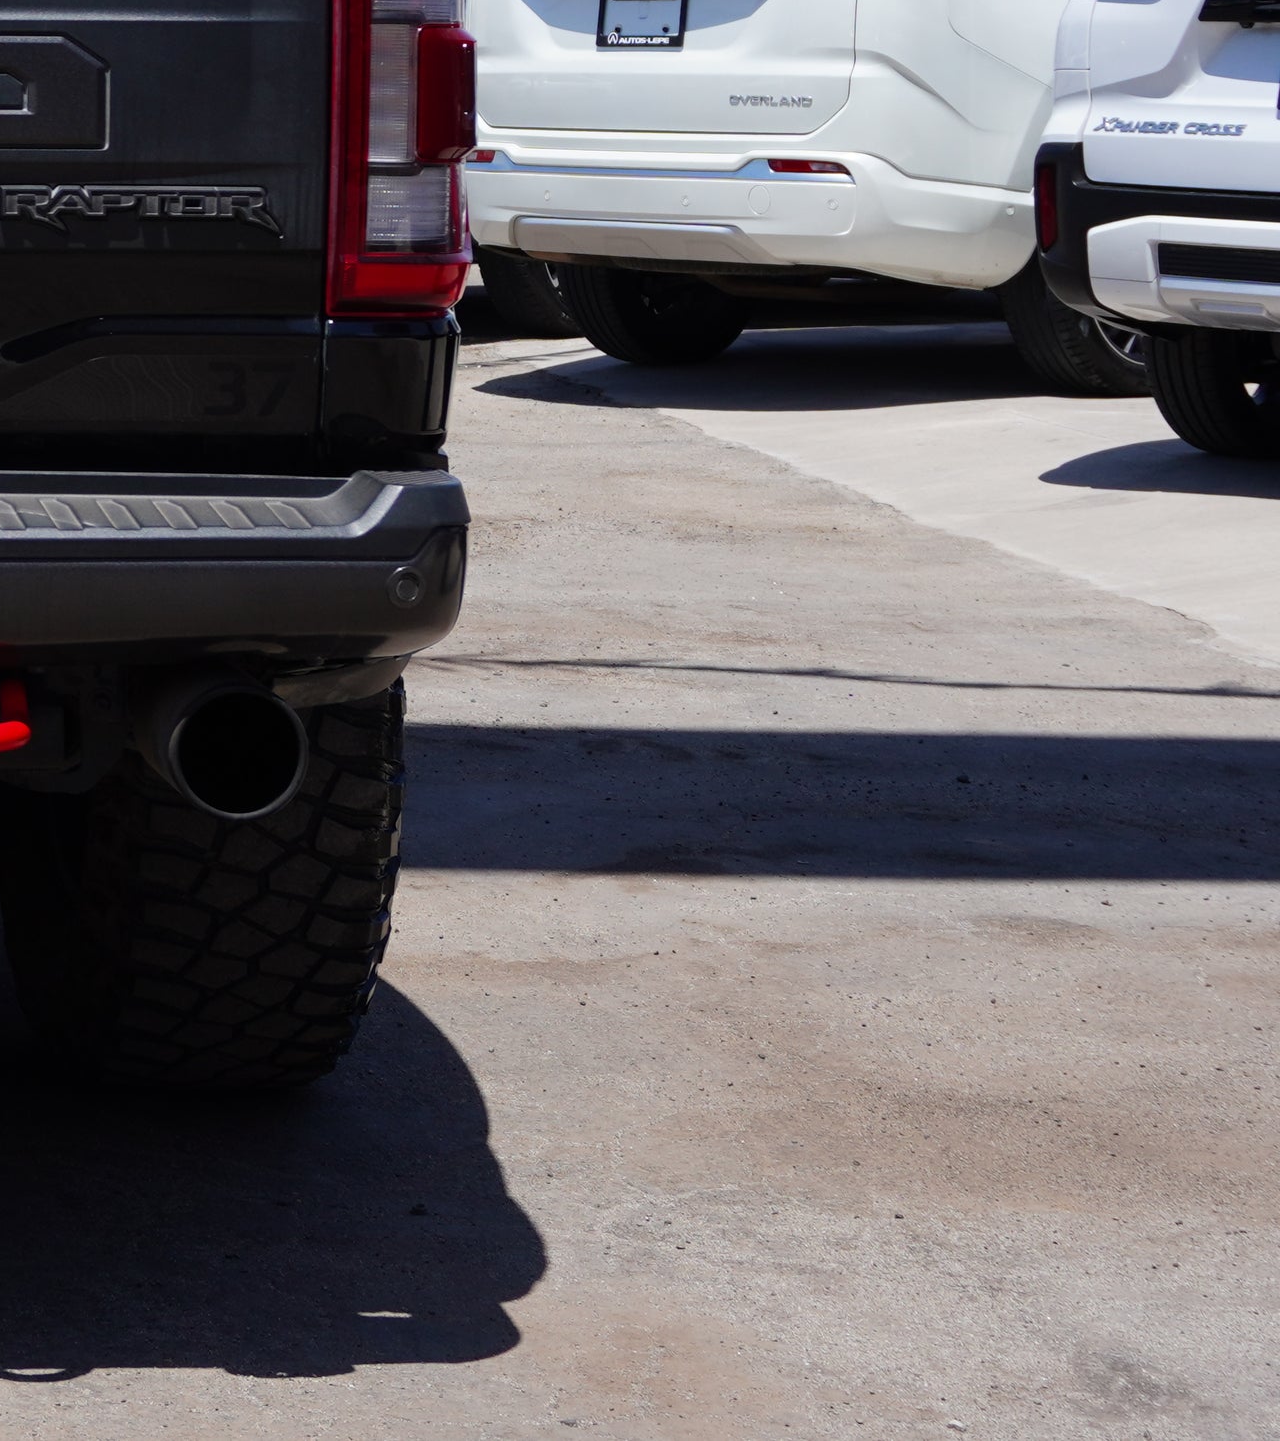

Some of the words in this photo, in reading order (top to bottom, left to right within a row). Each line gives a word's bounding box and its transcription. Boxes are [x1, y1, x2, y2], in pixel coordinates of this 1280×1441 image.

[729, 95, 813, 108] OVERLAND
[1093, 116, 1180, 134] XPANDER
[1184, 121, 1248, 137] CROSS
